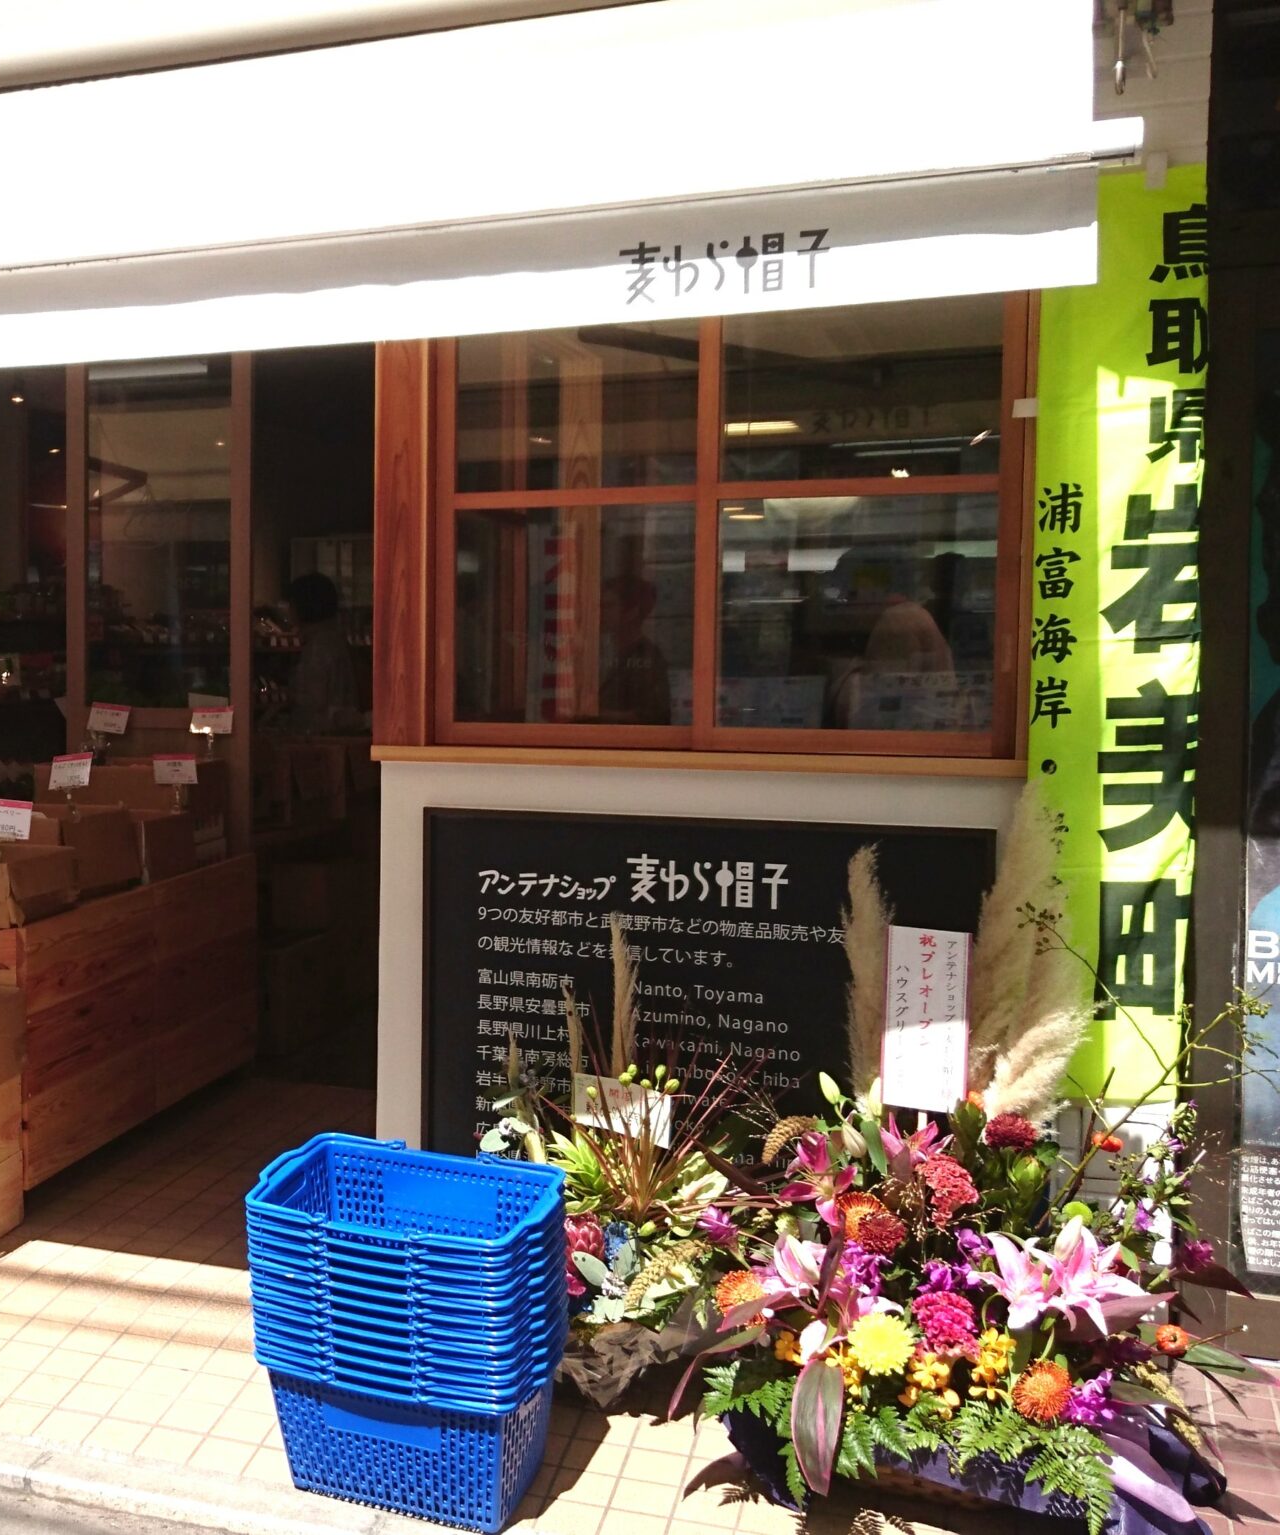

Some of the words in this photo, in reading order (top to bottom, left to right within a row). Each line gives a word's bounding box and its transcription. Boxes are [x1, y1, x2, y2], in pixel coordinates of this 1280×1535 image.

[619, 228, 830, 305] 麦わら帽子
[478, 869, 617, 902] アンテナショップ
[626, 853, 789, 910] 麦わら帽子
[477, 968, 575, 990] 富山県南砺市
[633, 980, 688, 1001] Nanto,
[693, 984, 764, 1005] Toyama
[631, 1006, 711, 1029] Azumino,
[718, 1013, 789, 1034] Nagano
[730, 1041, 801, 1062] Nagano
[749, 1070, 801, 1089] Chiba
